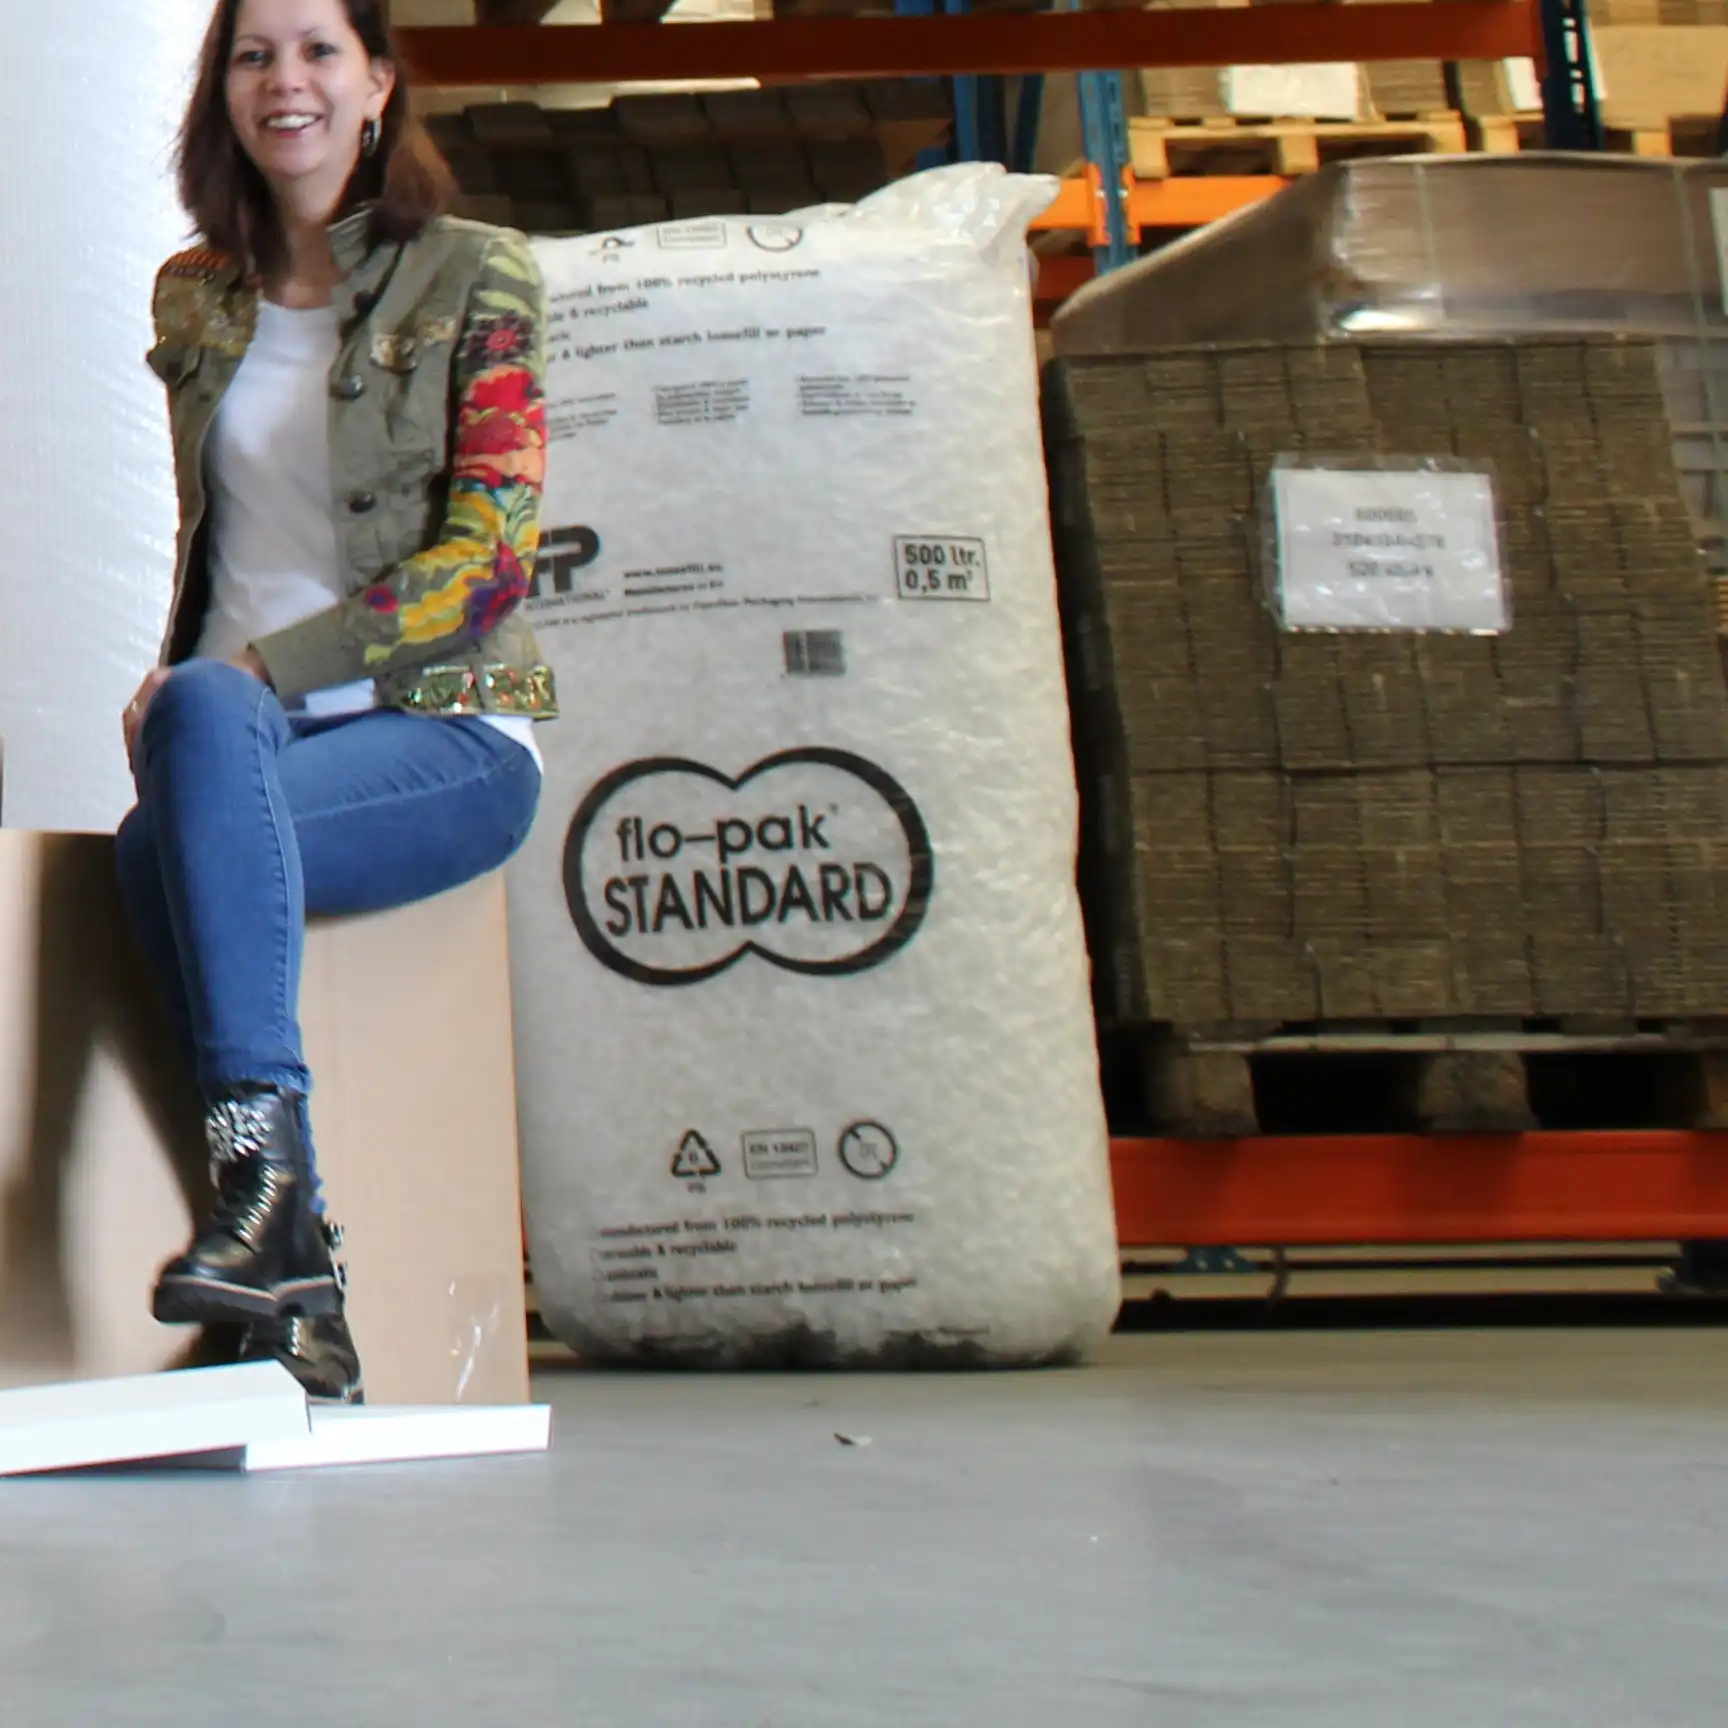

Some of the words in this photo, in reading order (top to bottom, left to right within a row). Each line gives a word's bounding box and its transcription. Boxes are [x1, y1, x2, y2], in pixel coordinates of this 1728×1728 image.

[678, 272, 735, 288] recycled
[584, 297, 650, 318] recyclable
[576, 342, 619, 361] lighter
[659, 332, 703, 347] starch
[904, 544, 946, 567] 500
[949, 544, 981, 567] ltr.
[905, 568, 942, 593] 0,5
[603, 861, 893, 937] STANDARD
